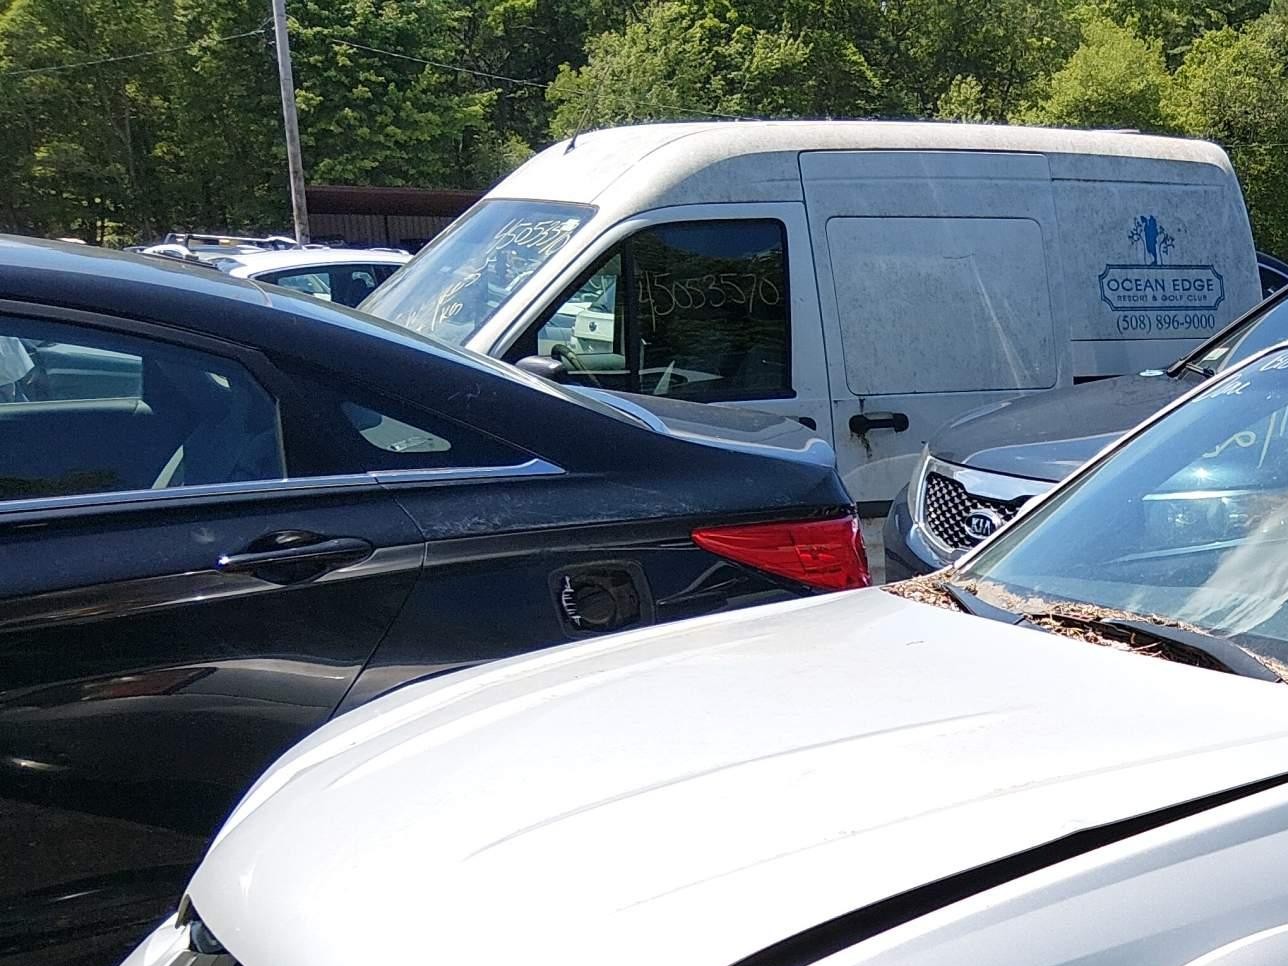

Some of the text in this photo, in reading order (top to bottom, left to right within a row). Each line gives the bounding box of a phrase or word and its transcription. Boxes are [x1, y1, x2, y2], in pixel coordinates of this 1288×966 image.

[1106, 278, 1215, 293] OCEAN EDGE
[638, 271, 780, 332] 45053570
[1117, 294, 1148, 302] RESORT
[1161, 294, 1183, 302] GOLF
[1187, 294, 1207, 302] CLUB
[1116, 313, 1215, 334] (508) 896-9000
[971, 517, 991, 536] KIA
